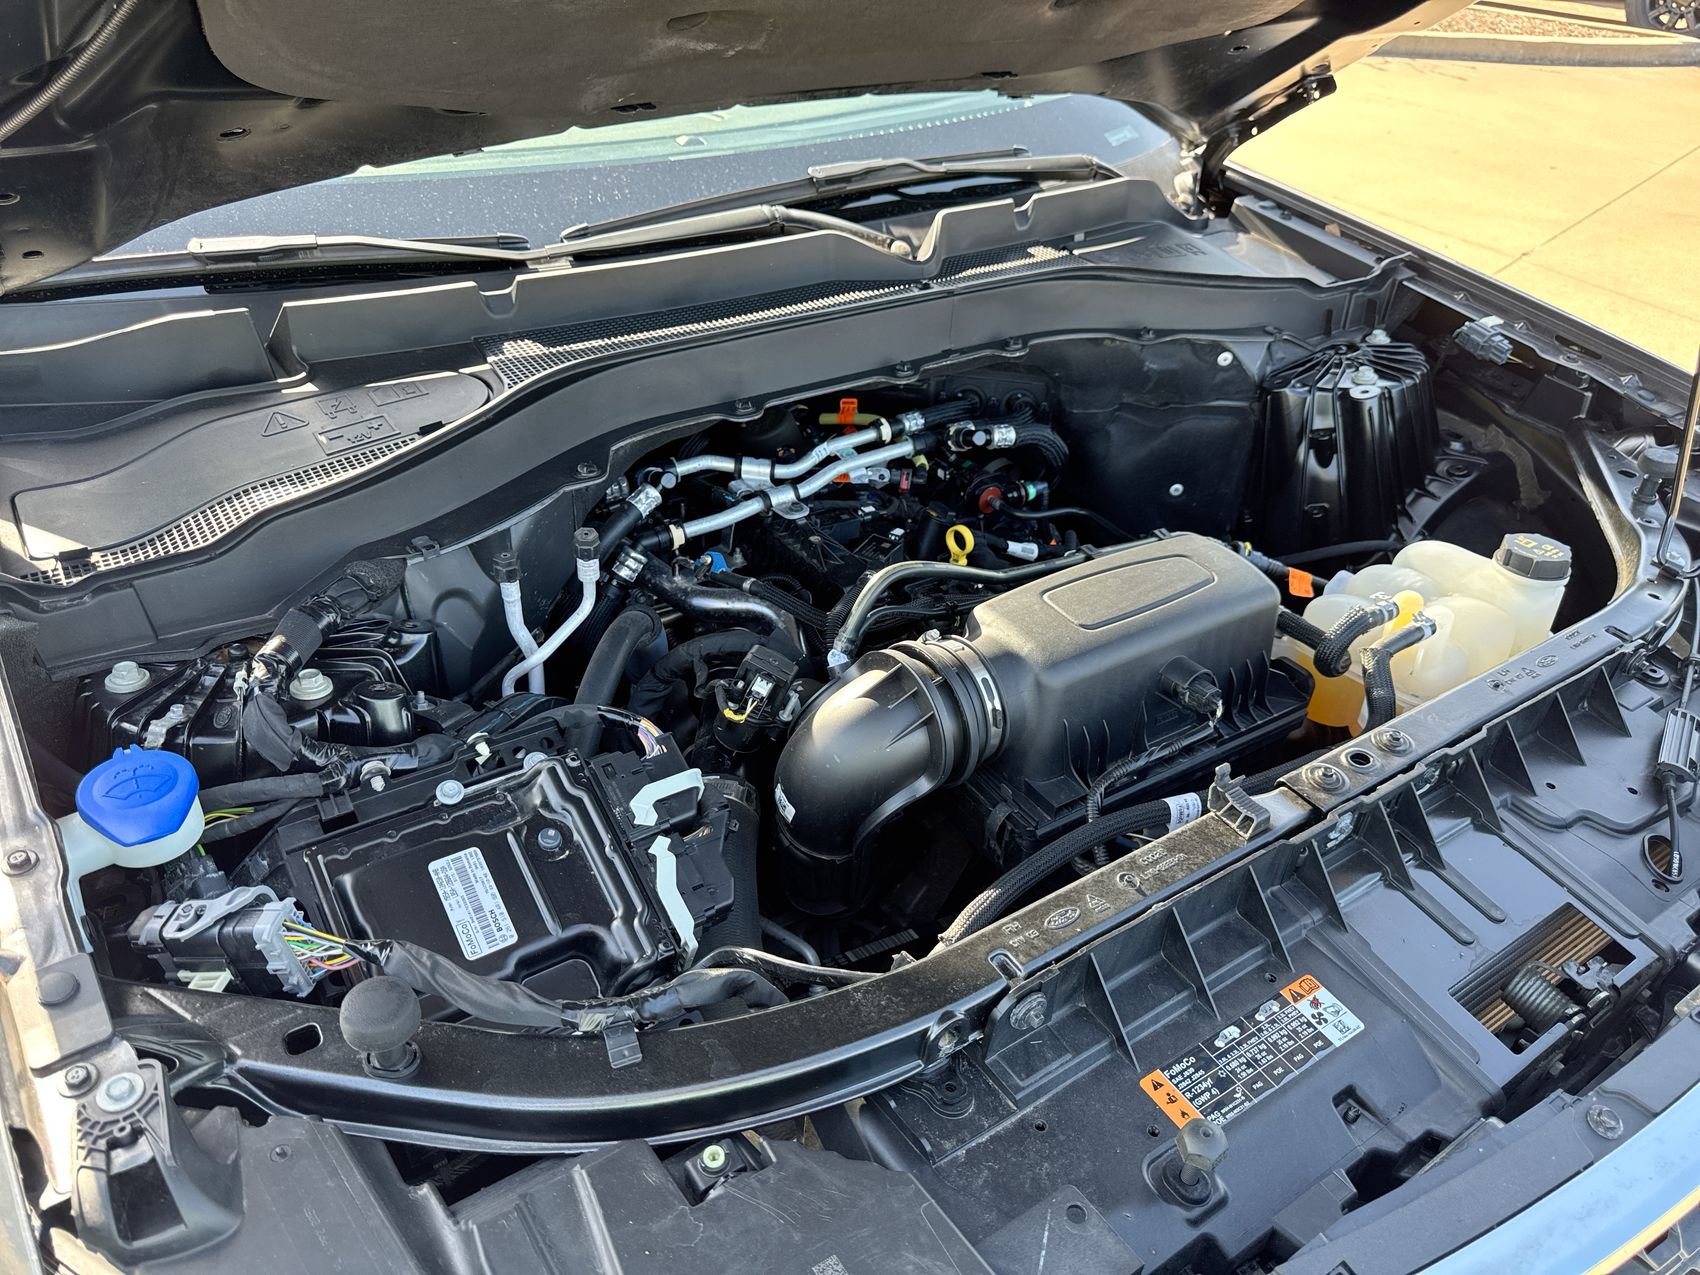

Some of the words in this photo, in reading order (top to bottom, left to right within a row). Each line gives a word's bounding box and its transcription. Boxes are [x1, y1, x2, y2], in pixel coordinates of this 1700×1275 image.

[488, 909, 503, 932] BOSCH
[461, 924, 478, 955] FoMoCo
[1164, 1057, 1196, 1078] FoMoCo
[1293, 1053, 1304, 1063] PAG
[1184, 1077, 1213, 1099] R-1234yf
[1252, 1080, 1264, 1090] PAG
[1192, 1092, 1210, 1108] (GWP
